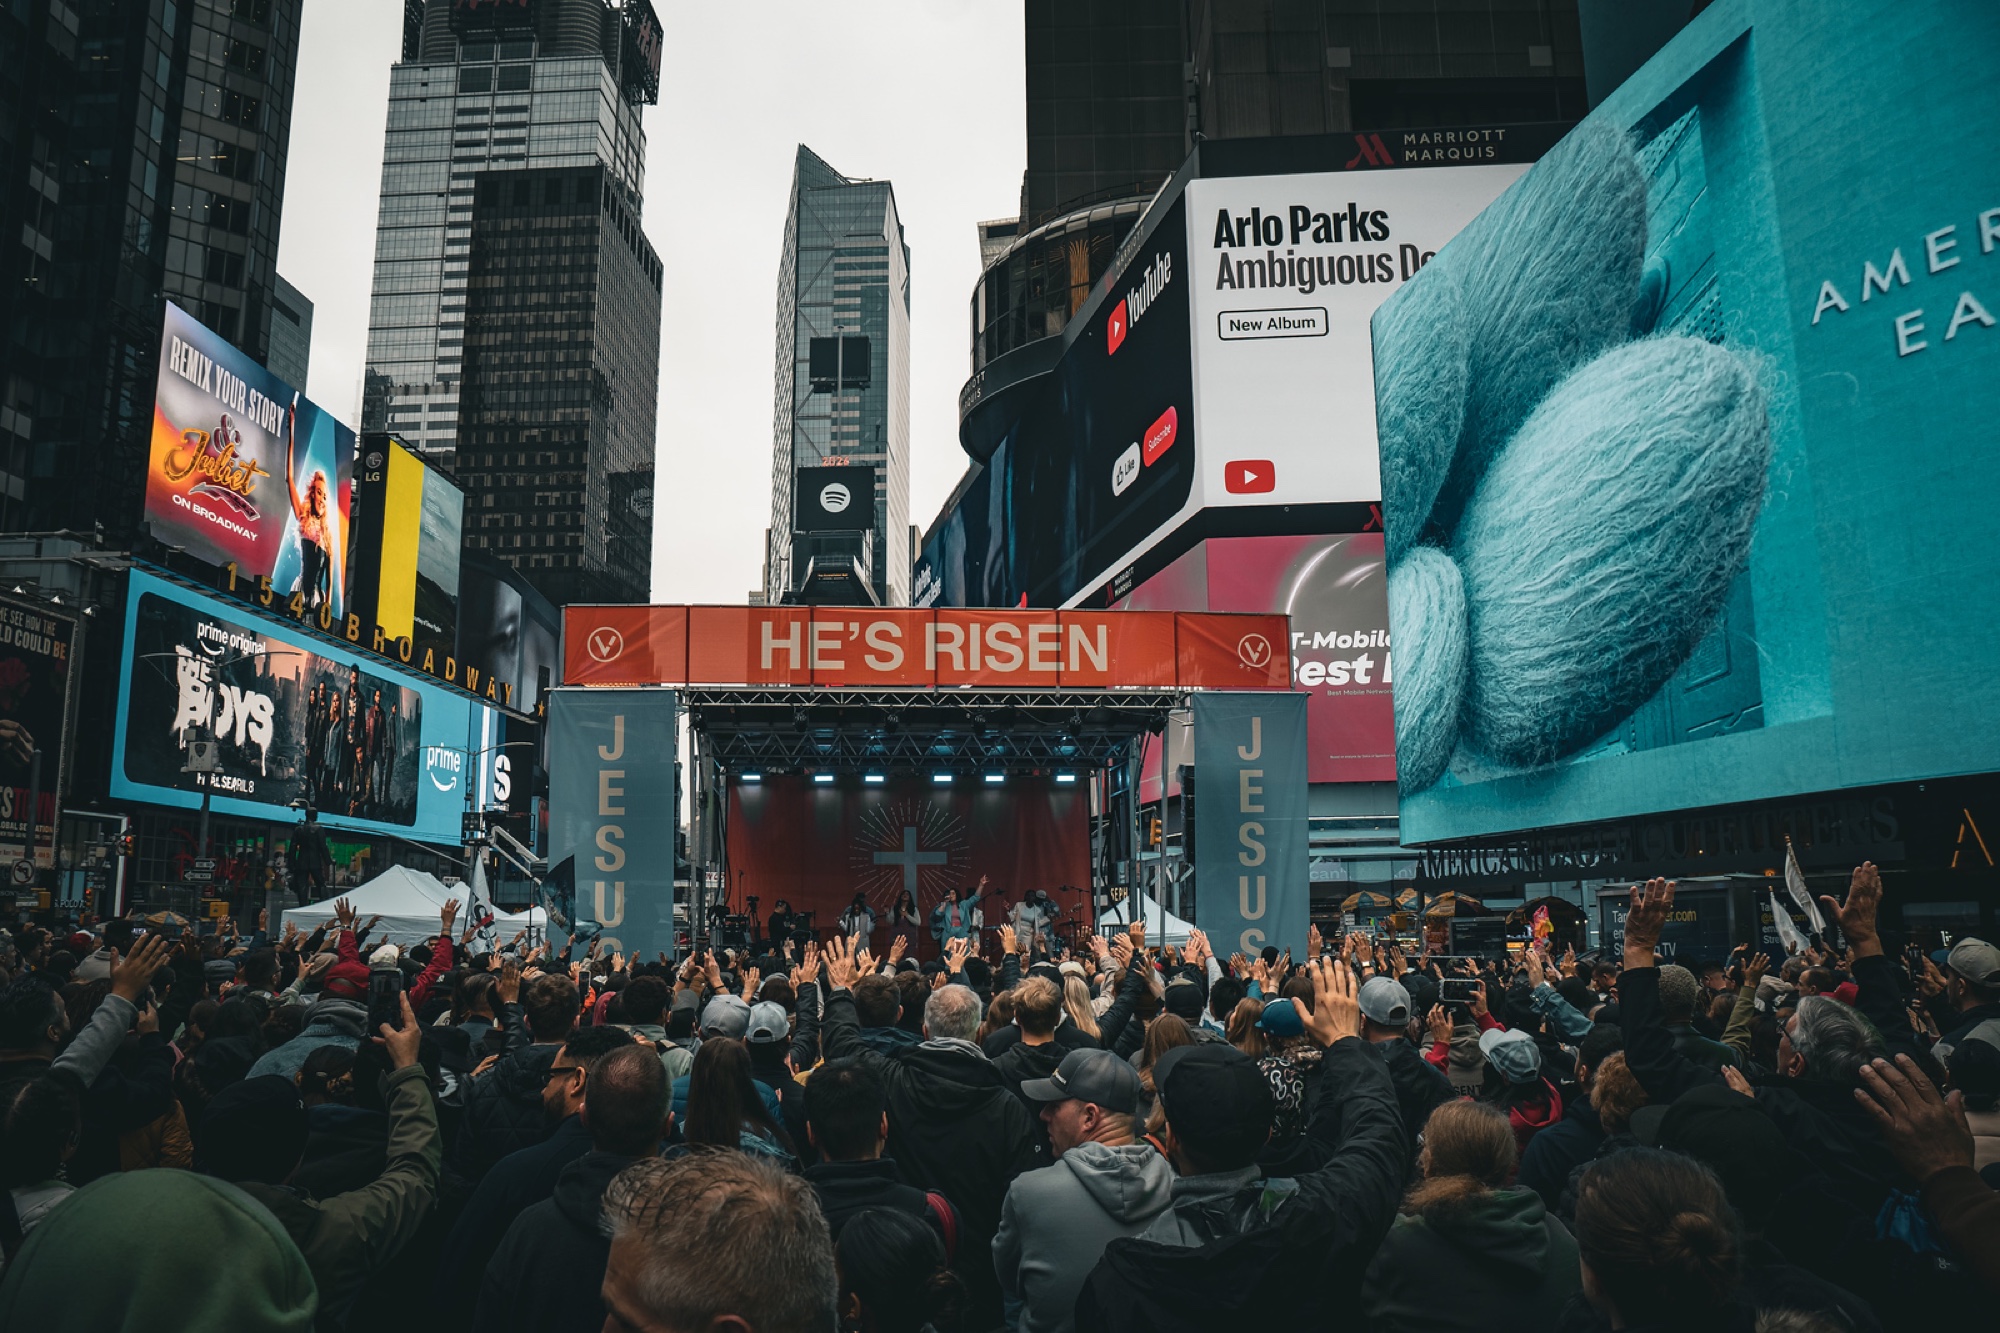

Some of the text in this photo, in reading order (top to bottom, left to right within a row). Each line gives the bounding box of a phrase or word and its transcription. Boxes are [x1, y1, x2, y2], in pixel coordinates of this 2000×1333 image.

[1404, 129, 1506, 145] MARRIOTT
[1405, 146, 1495, 161] MARQUIS
[1213, 202, 1391, 249] Arlo Parks
[1127, 251, 1172, 329] YouTube
[1215, 248, 1395, 295] Ambiguous
[1229, 316, 1316, 332] New Album
[1895, 291, 1997, 357] EA
[169, 335, 285, 438] REMIX YOUR STORY
[213, 412, 241, 459] &
[164, 427, 271, 496] Juliet
[365, 471, 381, 482] LG
[172, 494, 259, 542] ON BROADWAY
[15, 629, 51, 656] COULD
[52, 640, 67, 660] BE
[196, 621, 267, 657] prime original
[226, 561, 513, 706] 1540 BROADWAY
[761, 620, 905, 672] HE'S
[925, 621, 1109, 673] RISEN
[1327, 689, 1342, 697] Best
[1343, 688, 1365, 696] Mobile
[172, 680, 275, 757] BOYS
[426, 742, 461, 773] prime
[1662, 942, 1676, 957] TV
